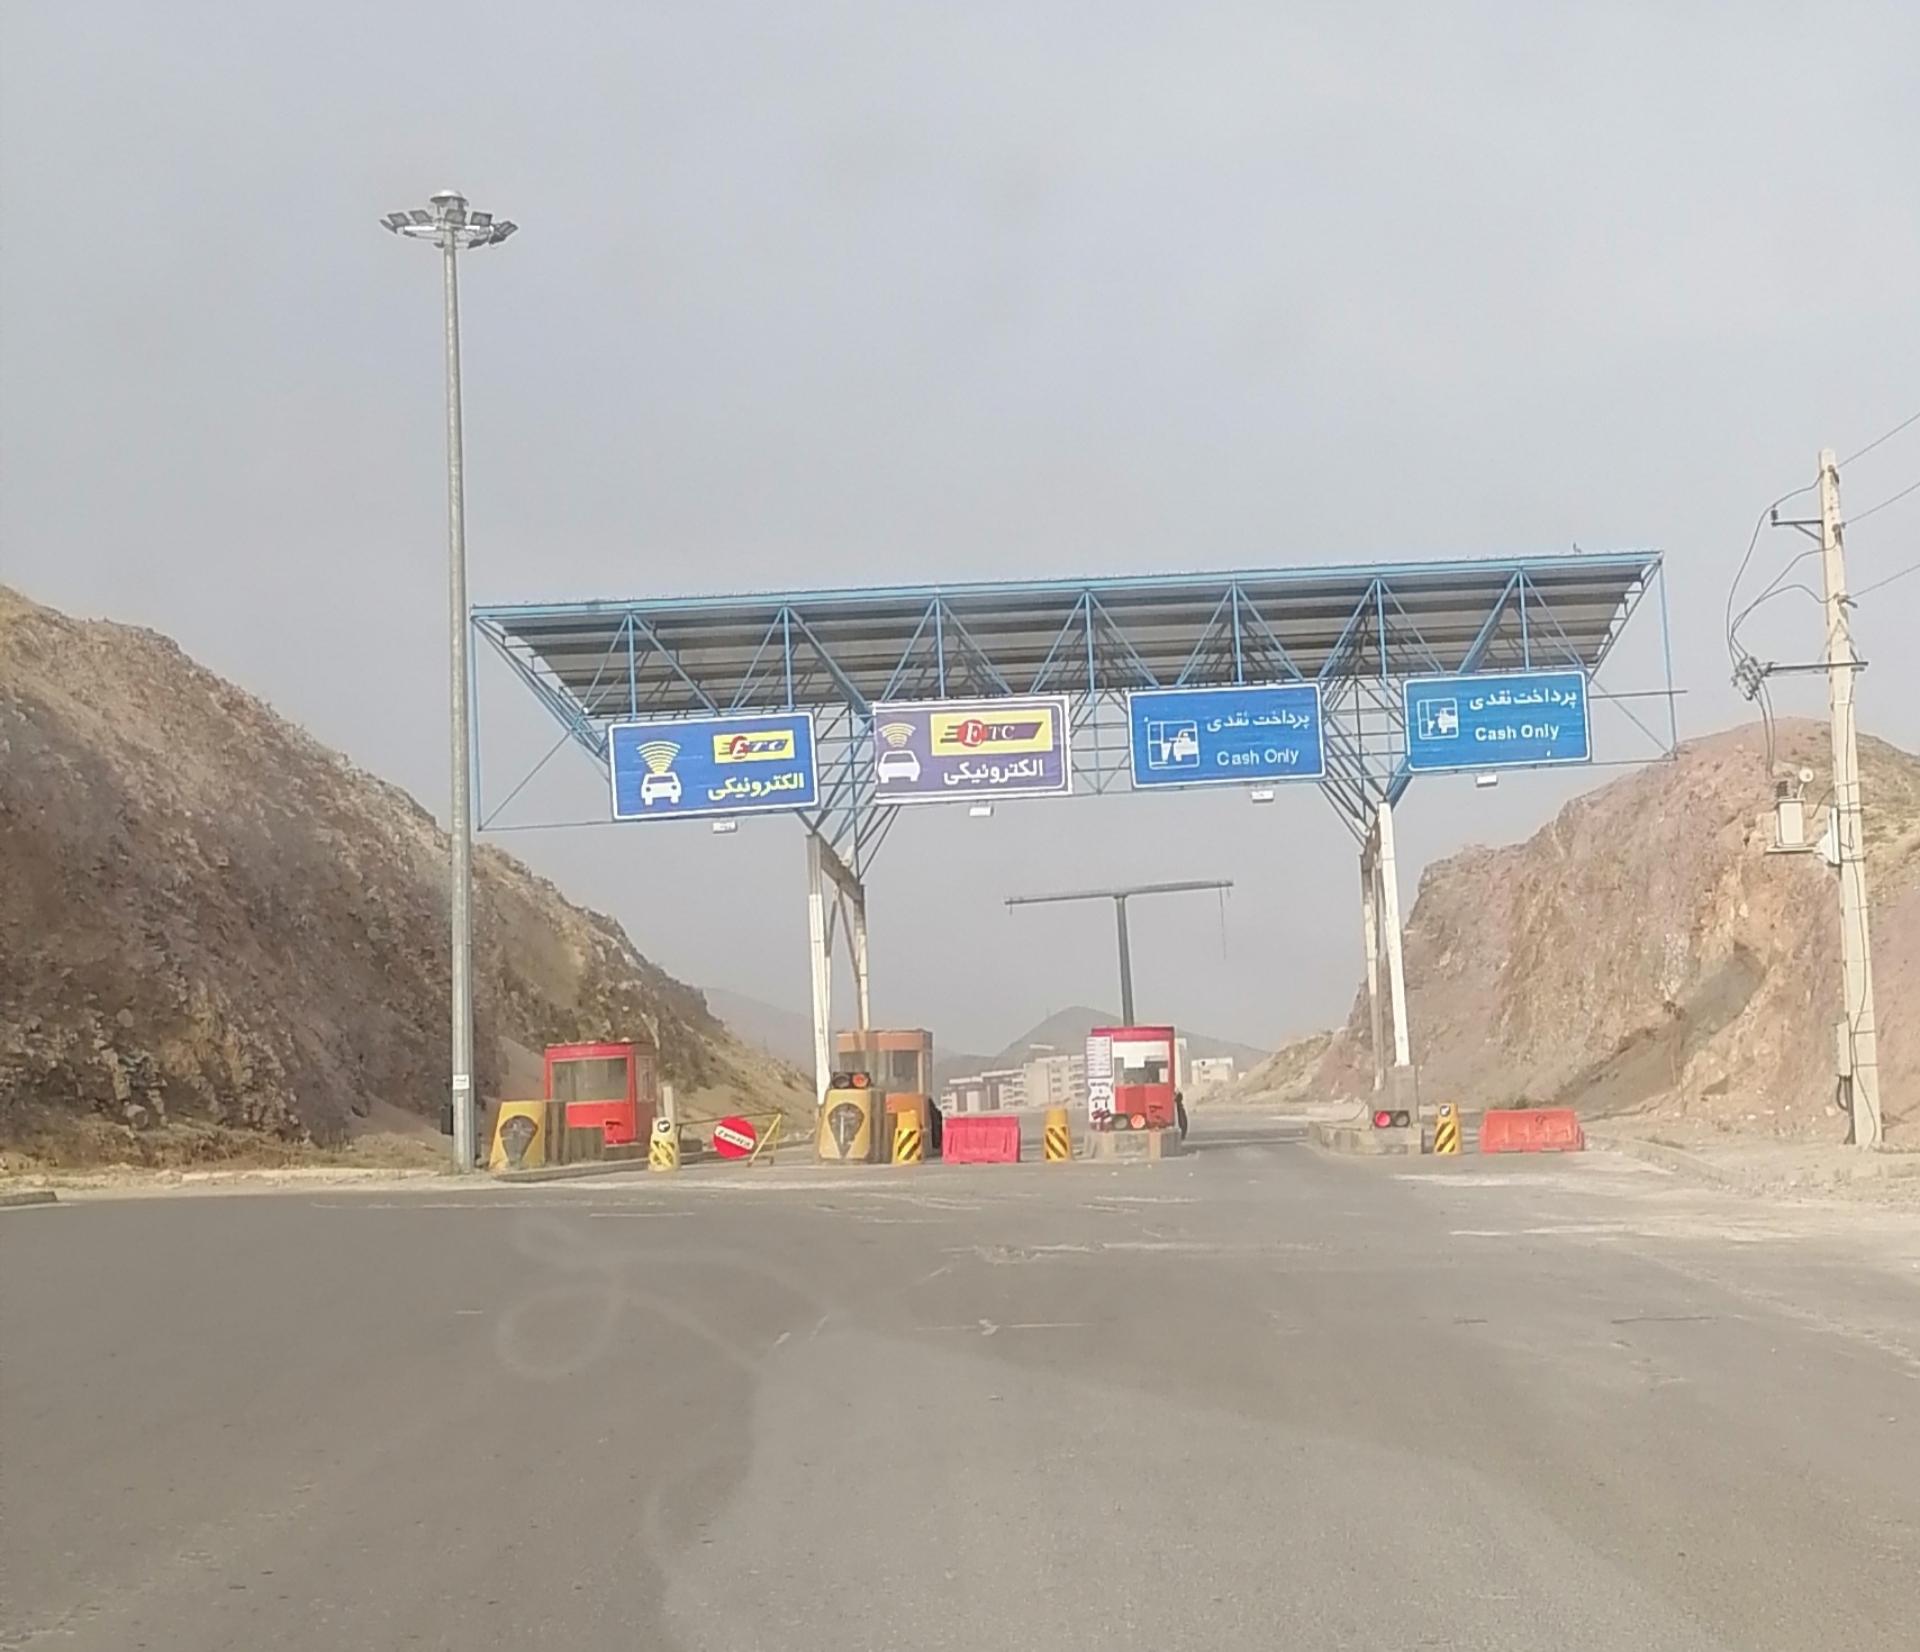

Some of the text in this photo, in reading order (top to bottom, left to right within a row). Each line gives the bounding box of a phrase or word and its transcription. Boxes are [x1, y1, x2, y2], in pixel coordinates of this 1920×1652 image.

[1469, 688, 1577, 710] پرداخت نقدی
[1207, 710, 1310, 732] پرداخت نقدی
[1475, 723, 1559, 741] Cash Only
[958, 720, 1015, 747] ETC
[730, 736, 783, 759] ETC
[1217, 749, 1299, 766] Cash Only
[944, 759, 1044, 785] الکترونیکی
[708, 772, 805, 800] الکترونیکی
